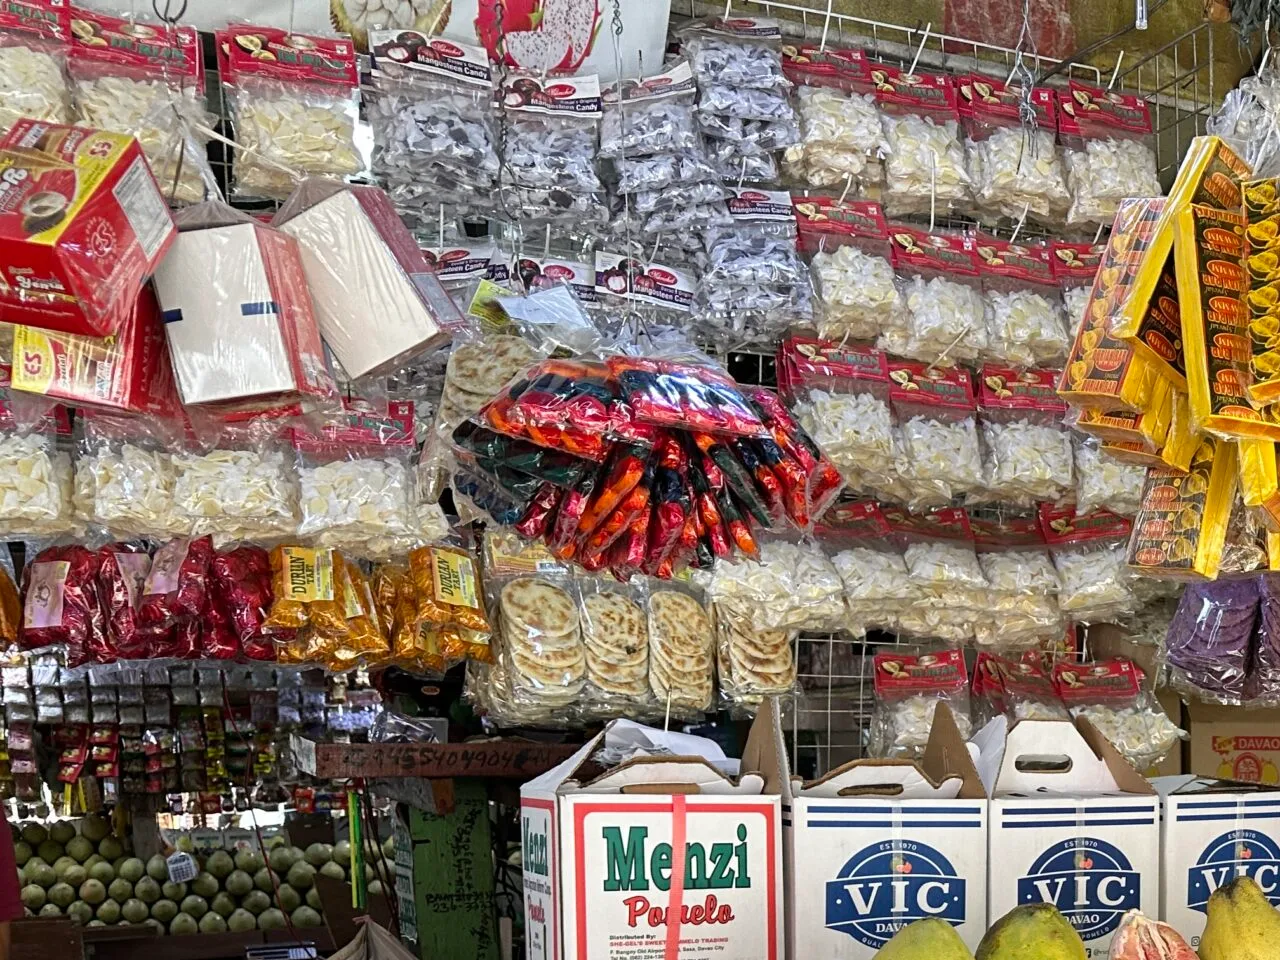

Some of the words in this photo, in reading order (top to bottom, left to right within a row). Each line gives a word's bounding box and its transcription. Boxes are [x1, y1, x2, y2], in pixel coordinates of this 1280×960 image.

[418, 55, 464, 73] Mangosteen
[464, 66, 487, 80] Candy
[576, 103, 598, 112] Candy
[771, 207, 792, 216] Candy
[292, 556, 307, 594] DURIAN
[306, 564, 315, 585] TART
[437, 557, 454, 596] DURIAN
[453, 568, 462, 592] TART
[1238, 737, 1280, 750] DAVAO
[522, 816, 549, 877] Menzi
[880, 842, 895, 851] EST
[1064, 841, 1079, 849] EST
[1081, 840, 1098, 849] 1970
[602, 823, 750, 892] Menzi
[843, 881, 950, 916] VIC
[1033, 875, 1127, 907] VIC
